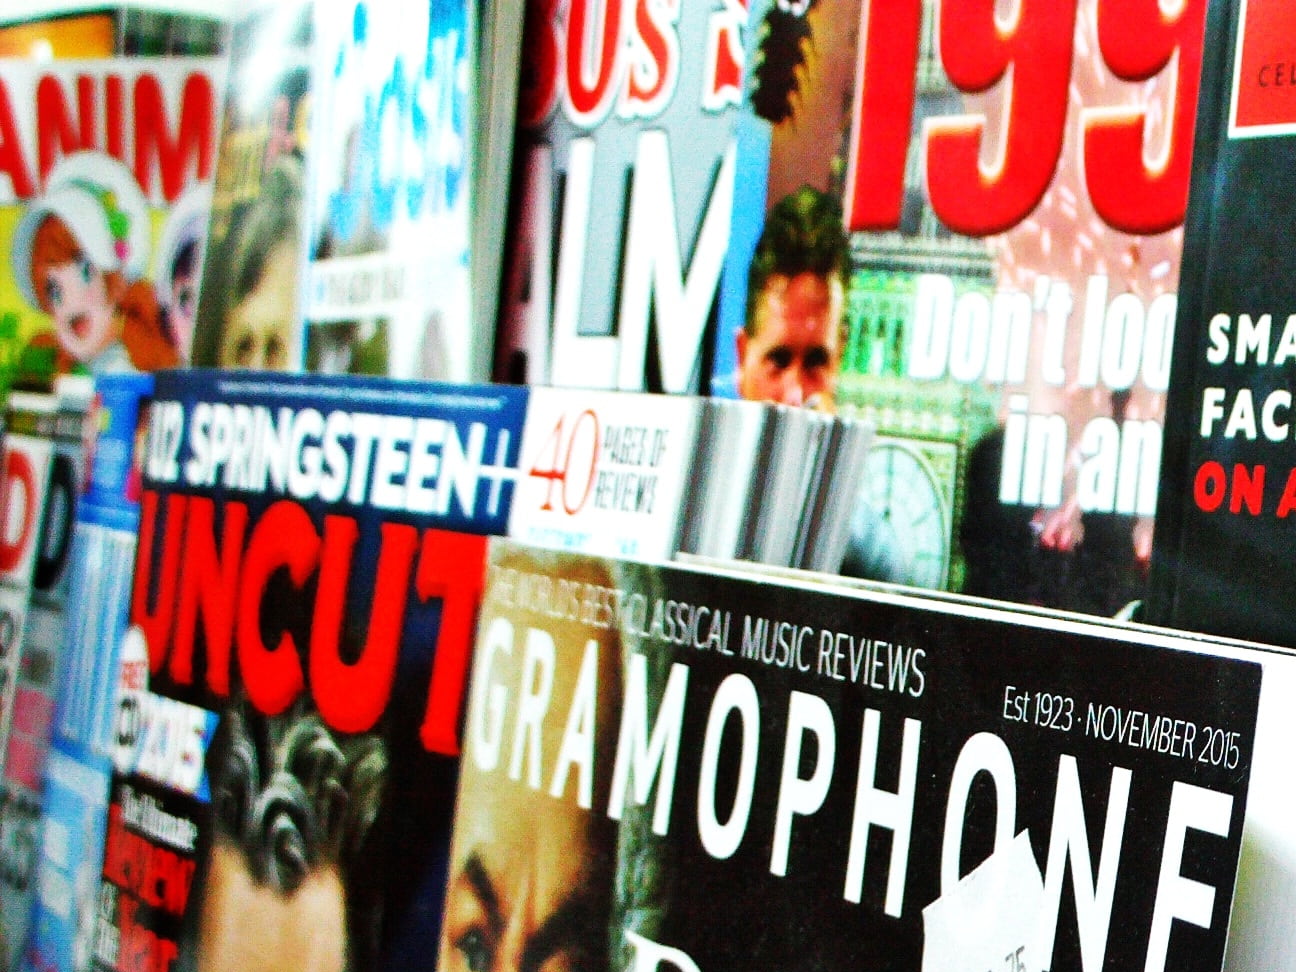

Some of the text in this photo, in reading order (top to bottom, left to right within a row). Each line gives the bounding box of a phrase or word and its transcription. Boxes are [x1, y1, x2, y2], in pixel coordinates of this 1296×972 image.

[908, 273, 1073, 384] Don't
[528, 408, 600, 517] 40
[998, 393, 1069, 509] in
[1193, 461, 1266, 517] ON
[130, 490, 488, 757] UNCUT
[625, 592, 735, 656] CLASSICAL
[740, 614, 815, 672] MUSIC
[816, 628, 927, 698] REVIEWS
[1002, 685, 1241, 770] Est 1923 NOVEMBER 2015
